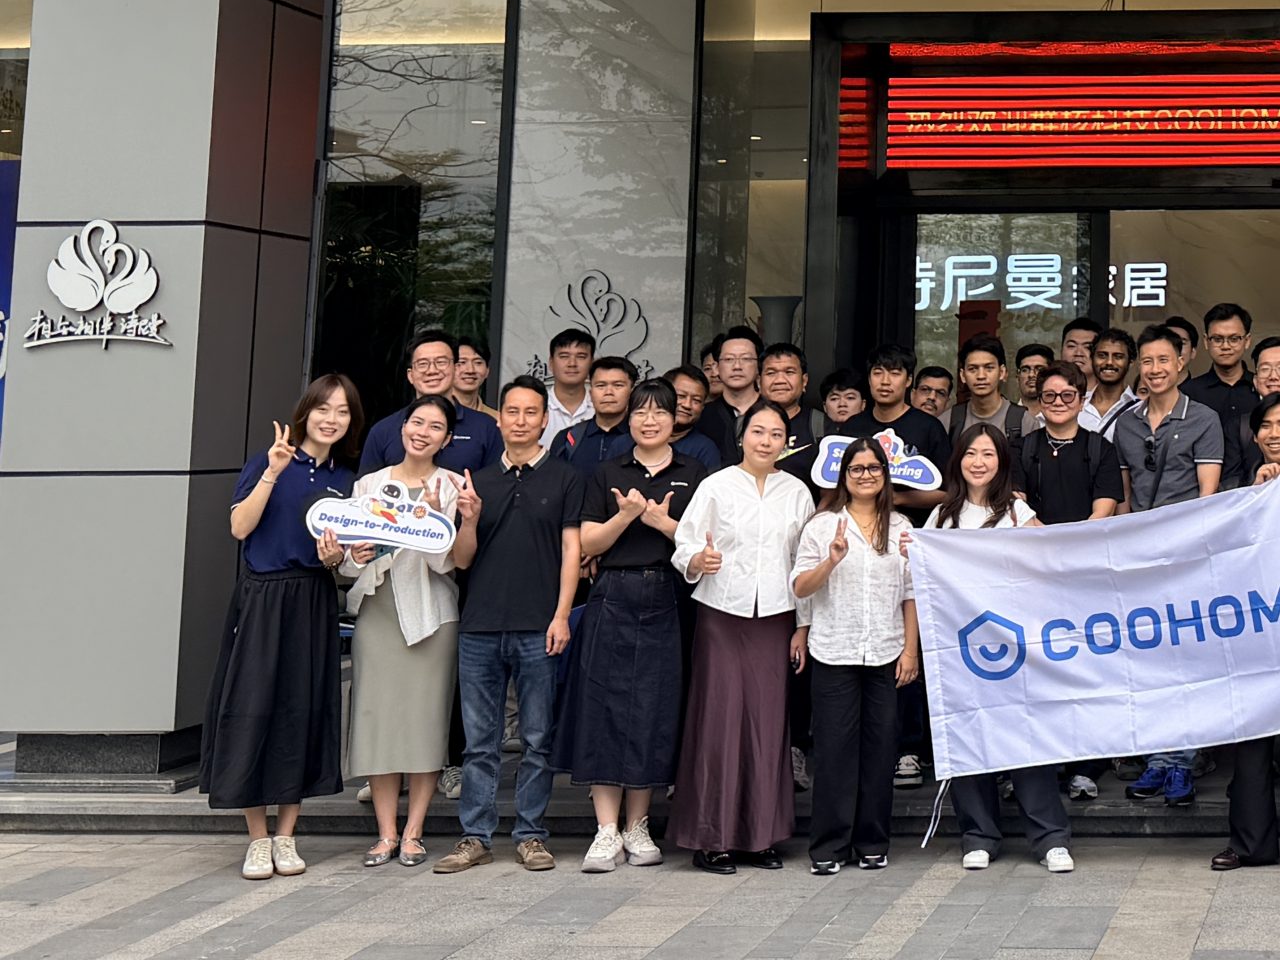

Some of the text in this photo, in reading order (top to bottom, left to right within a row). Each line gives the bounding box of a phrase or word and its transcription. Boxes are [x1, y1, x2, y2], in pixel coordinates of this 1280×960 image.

[914, 253, 1167, 311] 尼曼居
[318, 512, 445, 540] Design-to-Production
